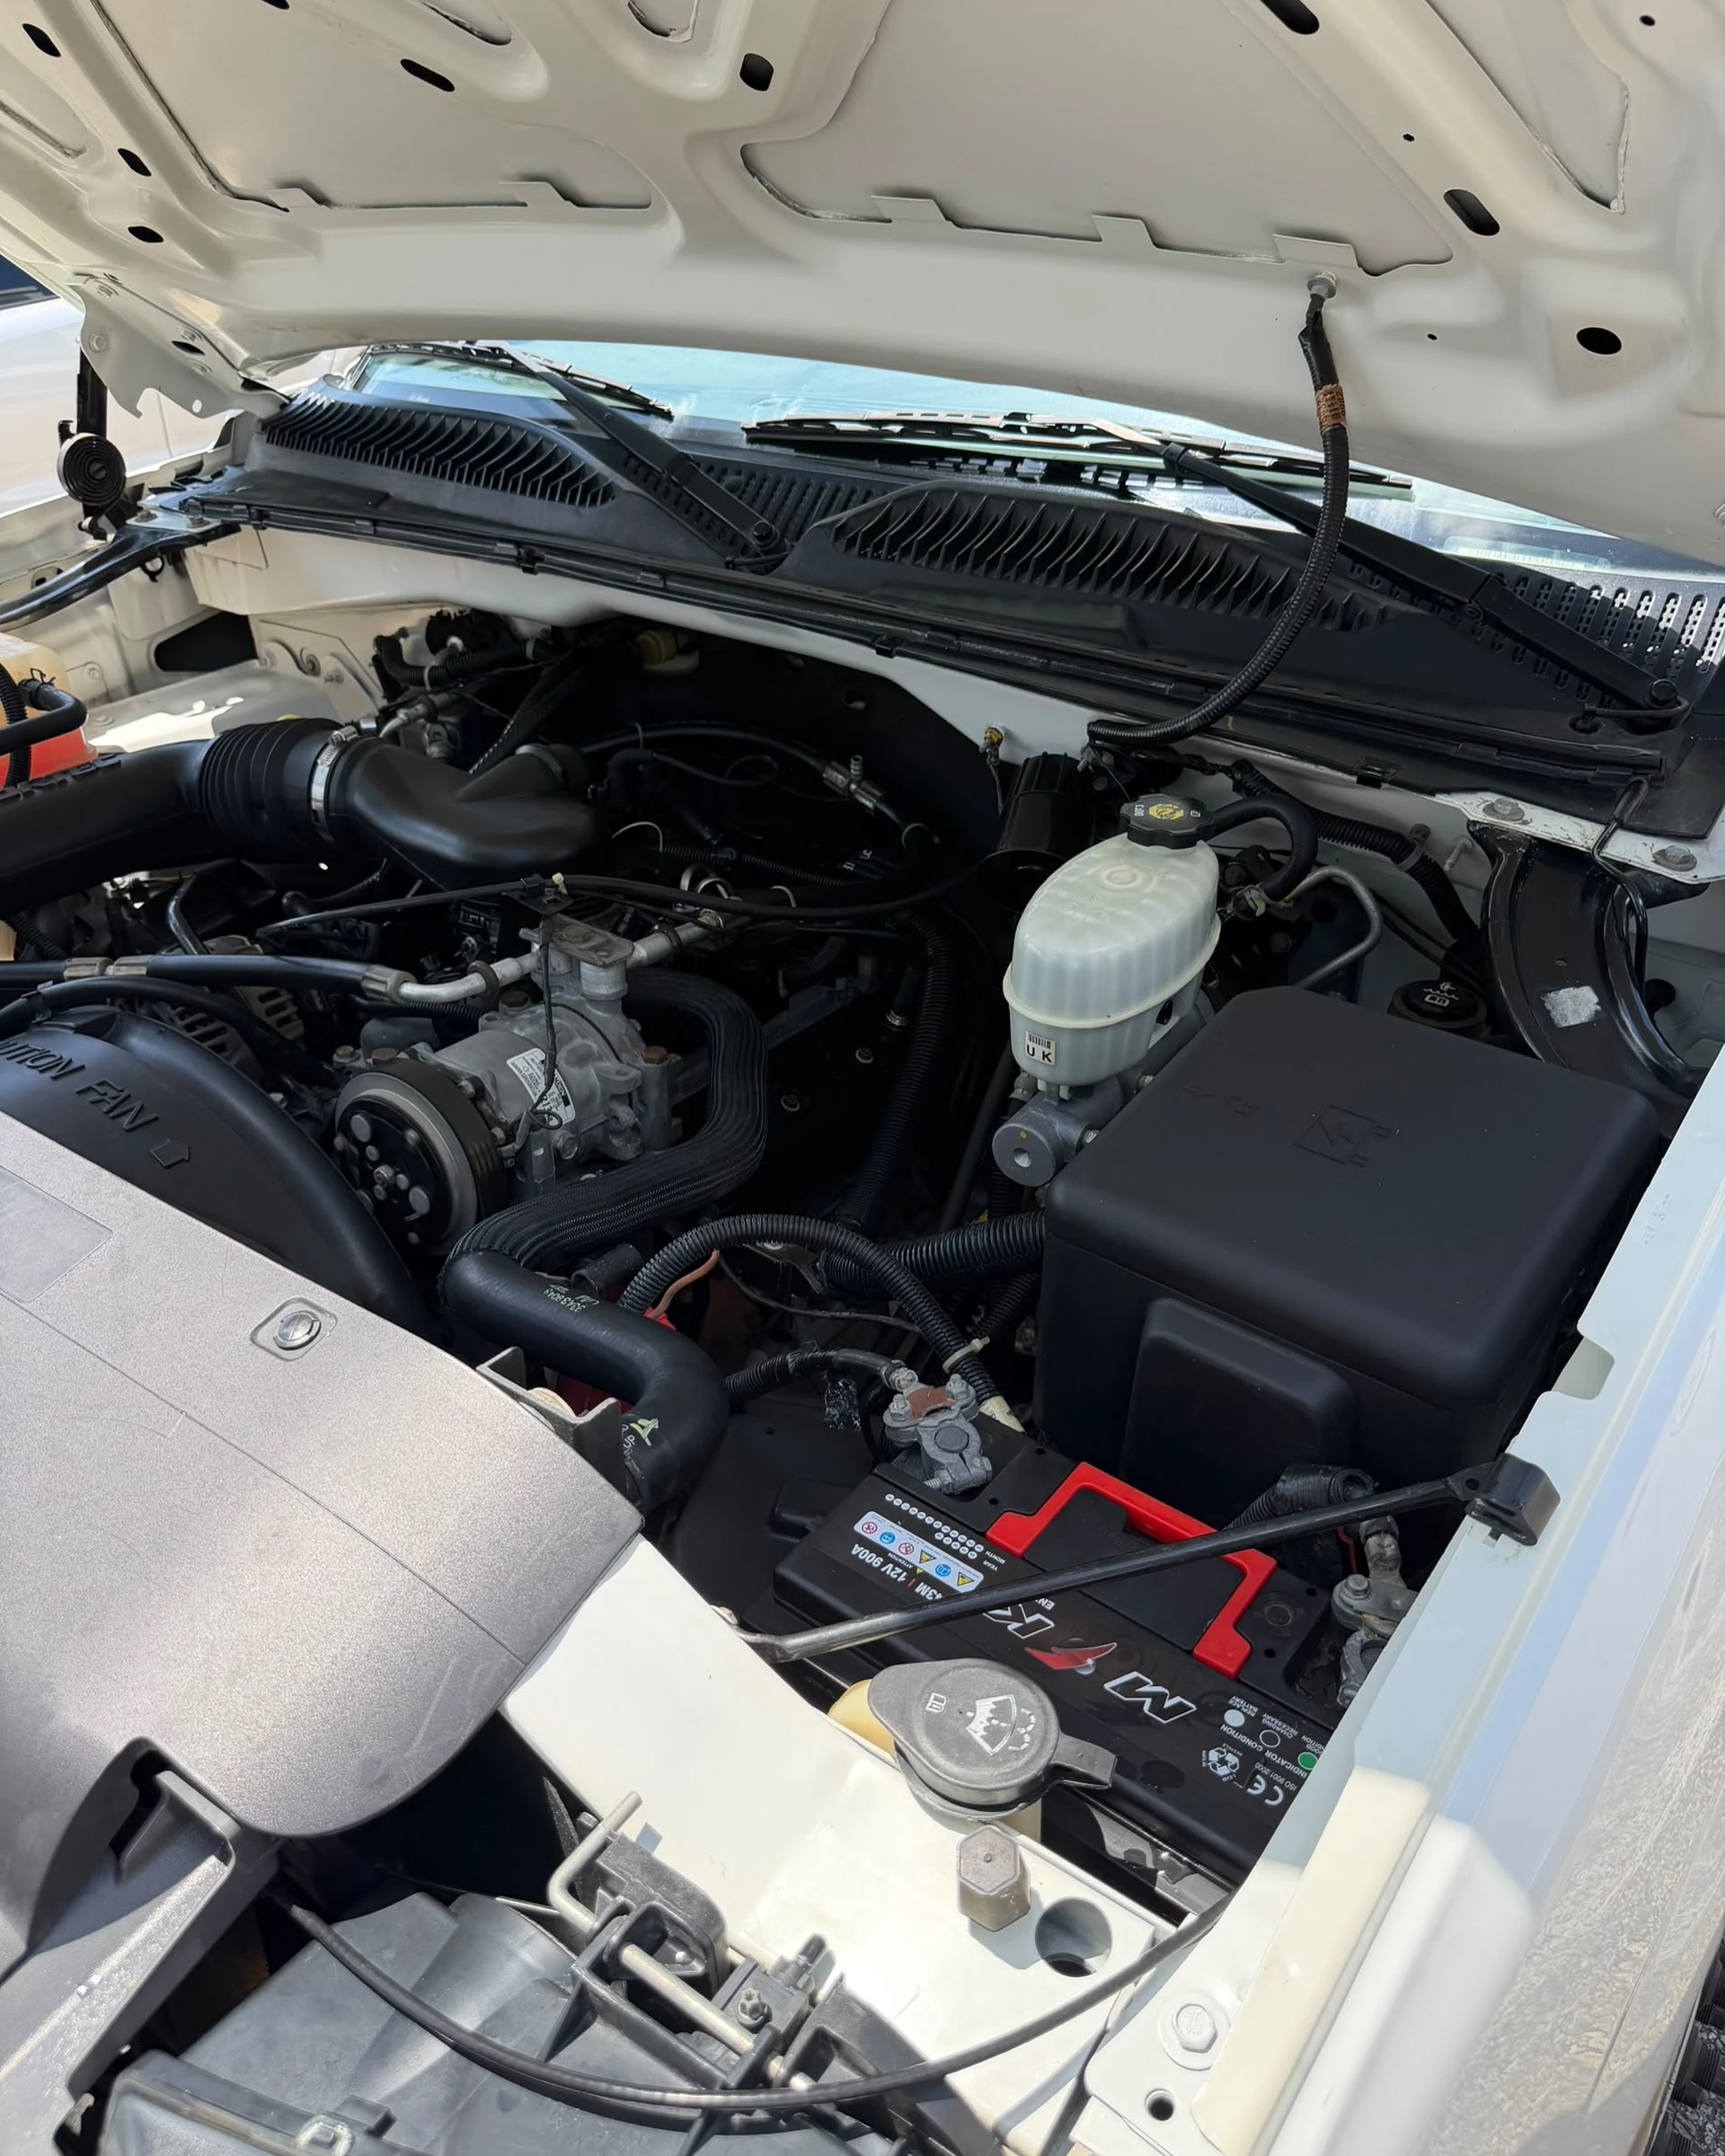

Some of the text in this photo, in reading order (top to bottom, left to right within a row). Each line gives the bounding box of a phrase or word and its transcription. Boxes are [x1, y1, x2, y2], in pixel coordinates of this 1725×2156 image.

[75, 1078, 159, 1132] FAN
[851, 1543, 884, 1567] 900A
[887, 1551, 914, 1569] ATTENTION
[985, 1550, 1006, 1565] MONTH
[884, 1562, 908, 1583] 12V
[982, 1560, 999, 1572] YEAR
[1227, 1698, 1256, 1718] REPLACE
[1231, 1695, 1259, 1713] BATTERY
[1261, 1712, 1299, 1736] NECESSARY
[1261, 1718, 1294, 1739] CHARGING
[1220, 1724, 1308, 1779] INDICATOR CONDITION
[1254, 1762, 1297, 1791] ISO 9001:2000
[1246, 1774, 1285, 1806] CE
